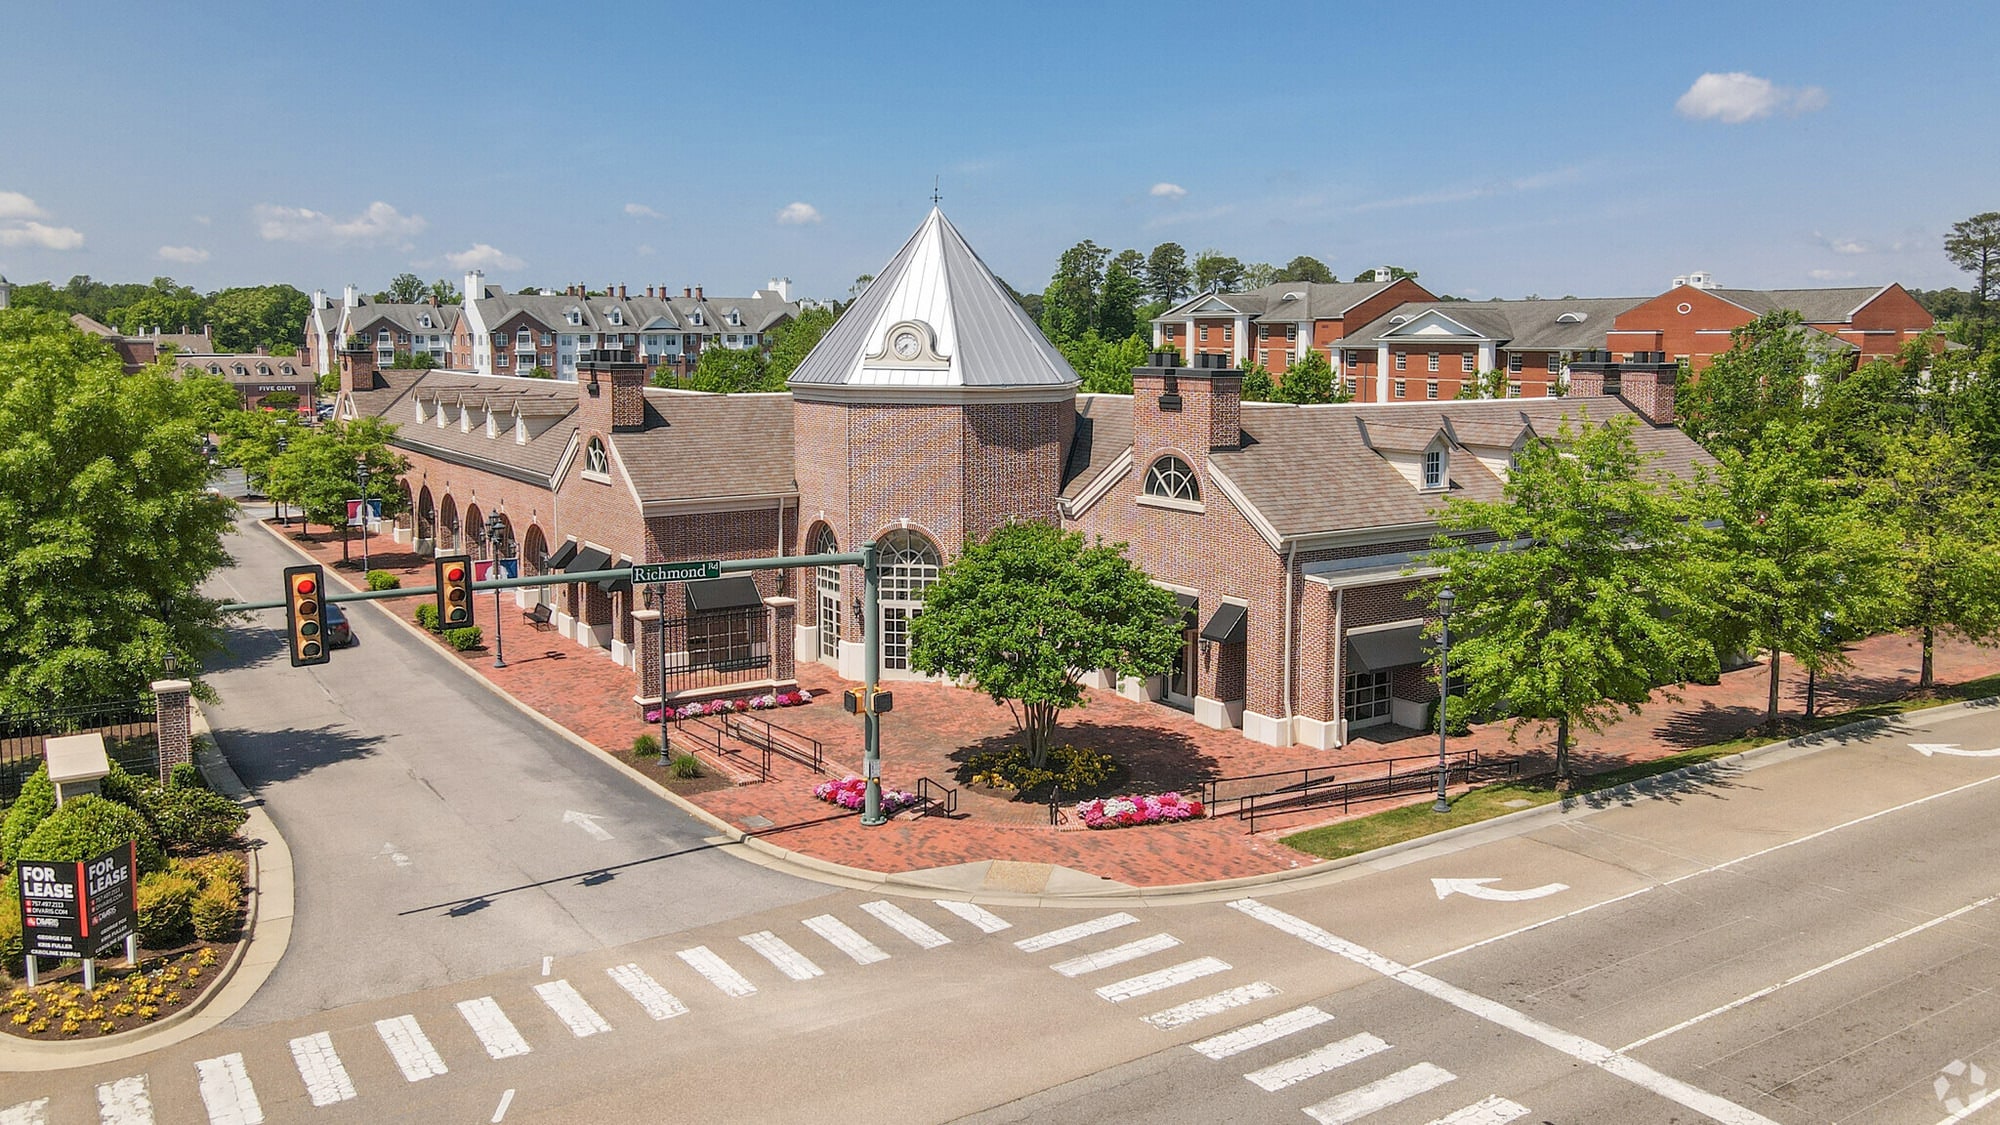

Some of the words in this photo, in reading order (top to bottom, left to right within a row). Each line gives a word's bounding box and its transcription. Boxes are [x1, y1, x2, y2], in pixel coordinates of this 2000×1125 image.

[634, 564, 706, 582] Richmond
[708, 562, 719, 570] Rd
[22, 866, 56, 882] FOR
[89, 857, 114, 881] FOR
[89, 865, 128, 896] LEASE
[23, 881, 74, 898] LEASE
[32, 907, 68, 915] DIVARIS.COM
[36, 917, 60, 928] DIVARIS
[118, 917, 128, 925] FOX
[111, 924, 128, 937] FULLER
[95, 937, 117, 954] CAROLINE
